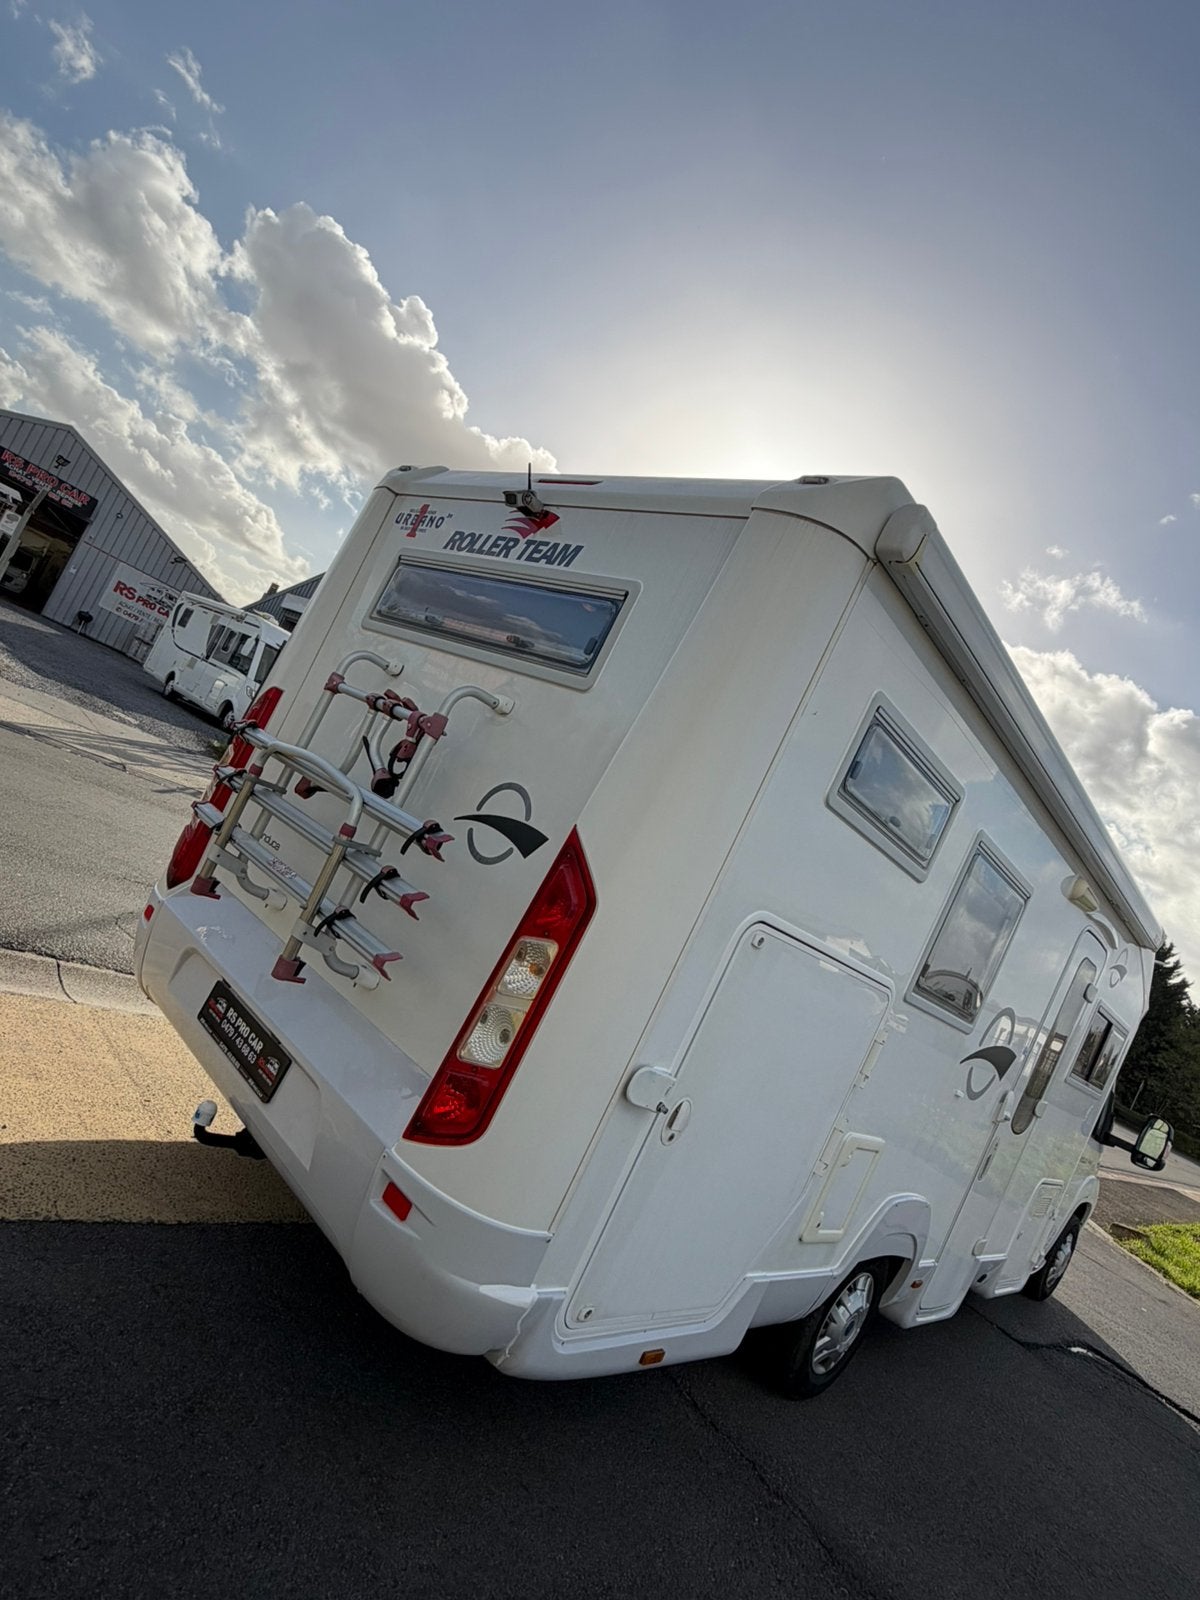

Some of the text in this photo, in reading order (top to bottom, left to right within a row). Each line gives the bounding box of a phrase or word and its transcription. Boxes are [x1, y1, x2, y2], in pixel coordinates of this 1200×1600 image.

[3, 462, 28, 476] ACHAT
[26, 463, 59, 488] PRO
[60, 483, 91, 506] CAR
[443, 530, 584, 568] ROLLER TEAM
[113, 580, 170, 619] RS PRO CA
[123, 610, 140, 621] 0479
[220, 1019, 235, 1038] 0479
[235, 1036, 244, 1049] 43
[247, 1051, 257, 1065] 63
[226, 1007, 238, 1023] RS
[235, 1018, 251, 1038] PRO
[247, 1032, 264, 1054] CAR
